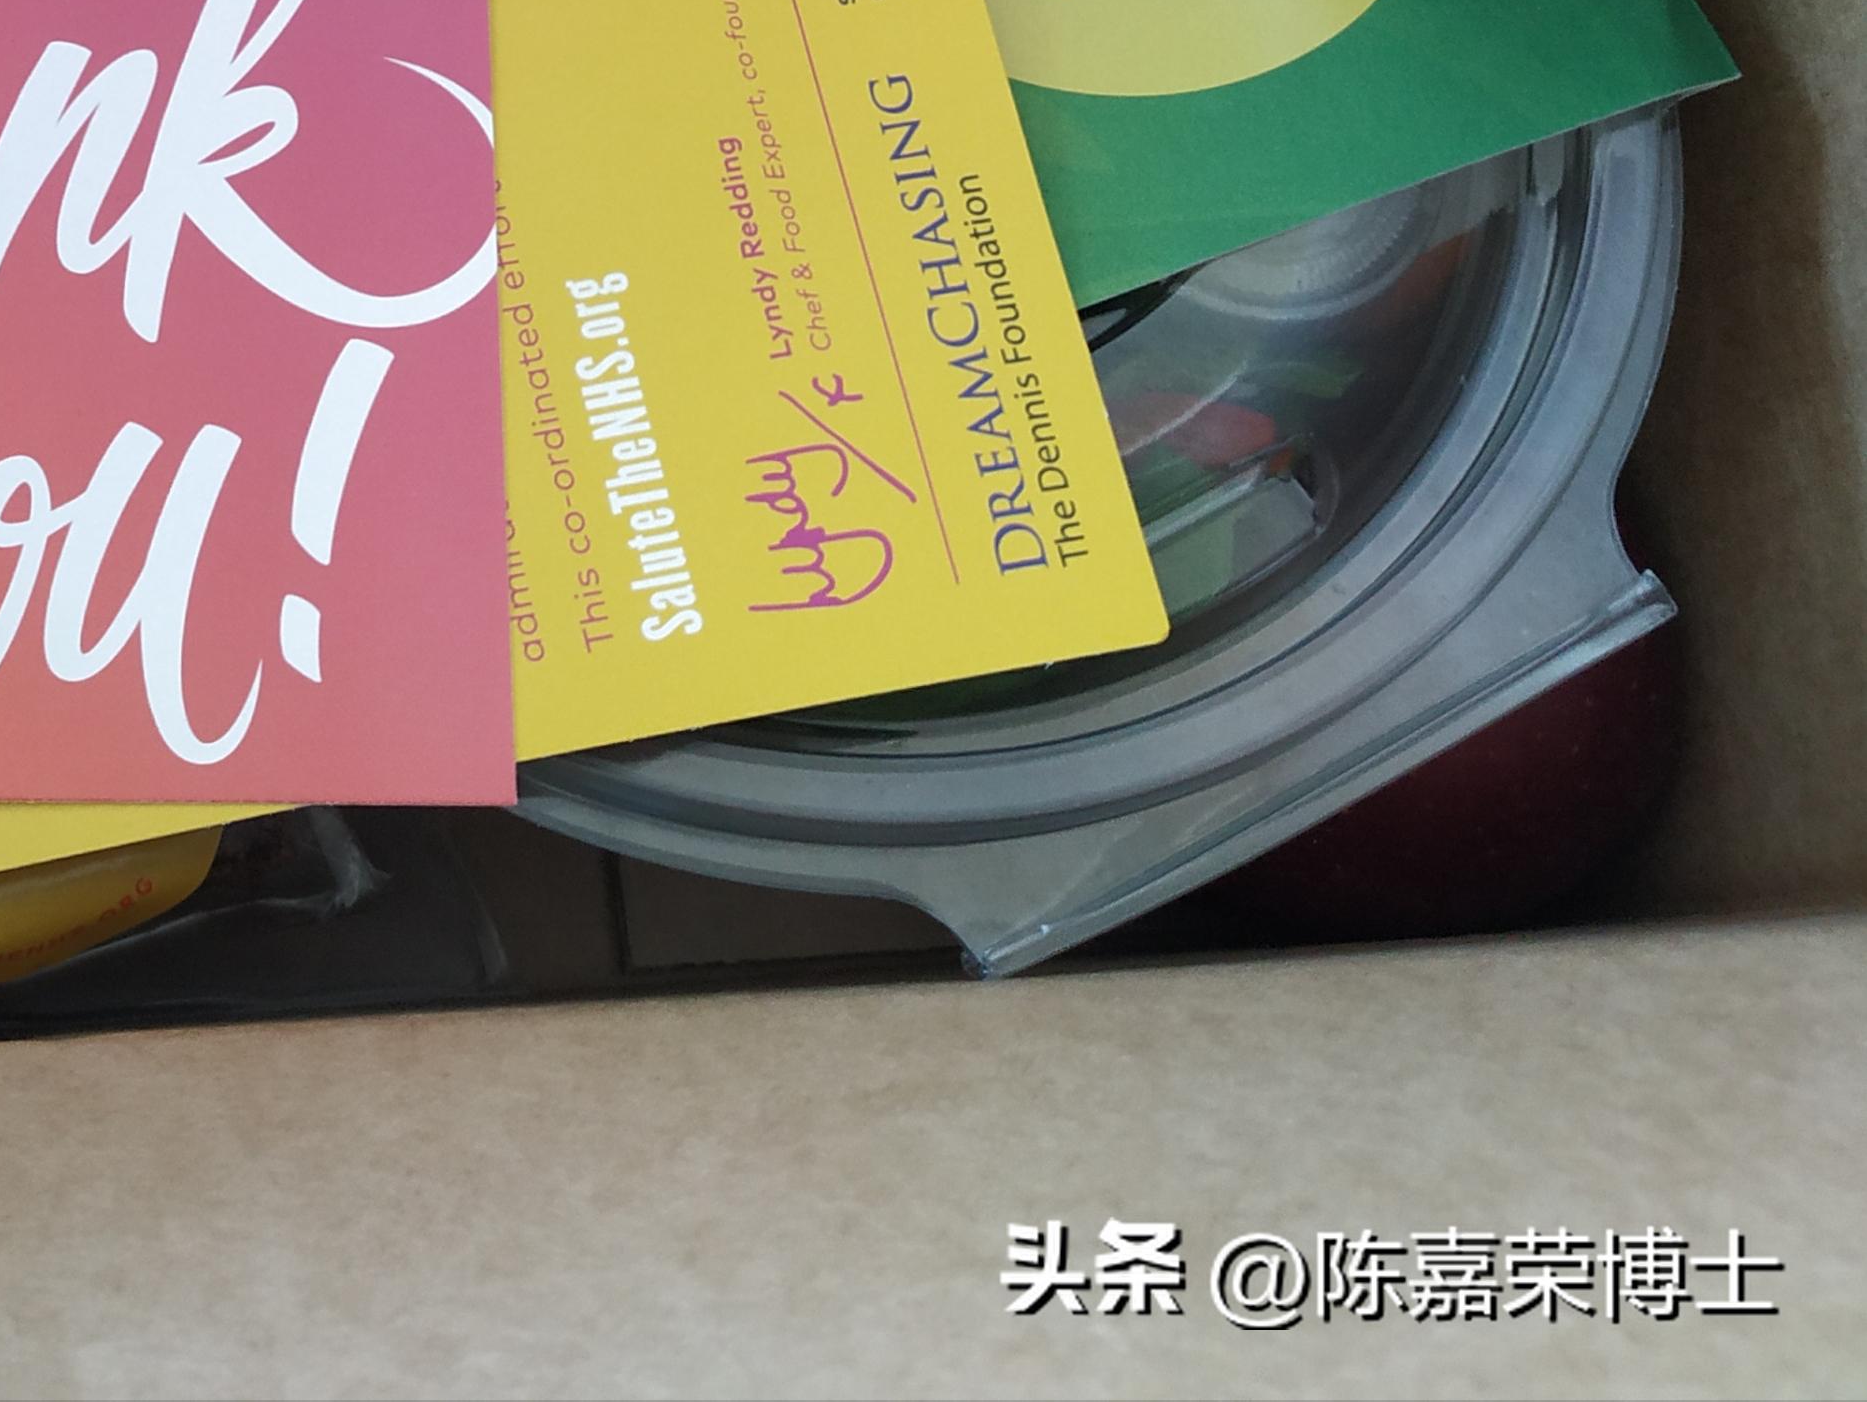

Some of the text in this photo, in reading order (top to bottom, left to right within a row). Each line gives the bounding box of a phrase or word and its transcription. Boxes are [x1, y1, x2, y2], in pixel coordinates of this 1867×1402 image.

[745, 88, 786, 179] Expert,
[717, 136, 794, 360] Lyndy Redding
[767, 188, 806, 253] Food
[789, 261, 813, 280] &
[794, 288, 832, 351] Chef
[958, 173, 1089, 569] The Dennis Foundation
[506, 302, 591, 555] co-ordinated
[564, 271, 704, 641] SaluteTheNHS.org
[572, 567, 614, 654] This
